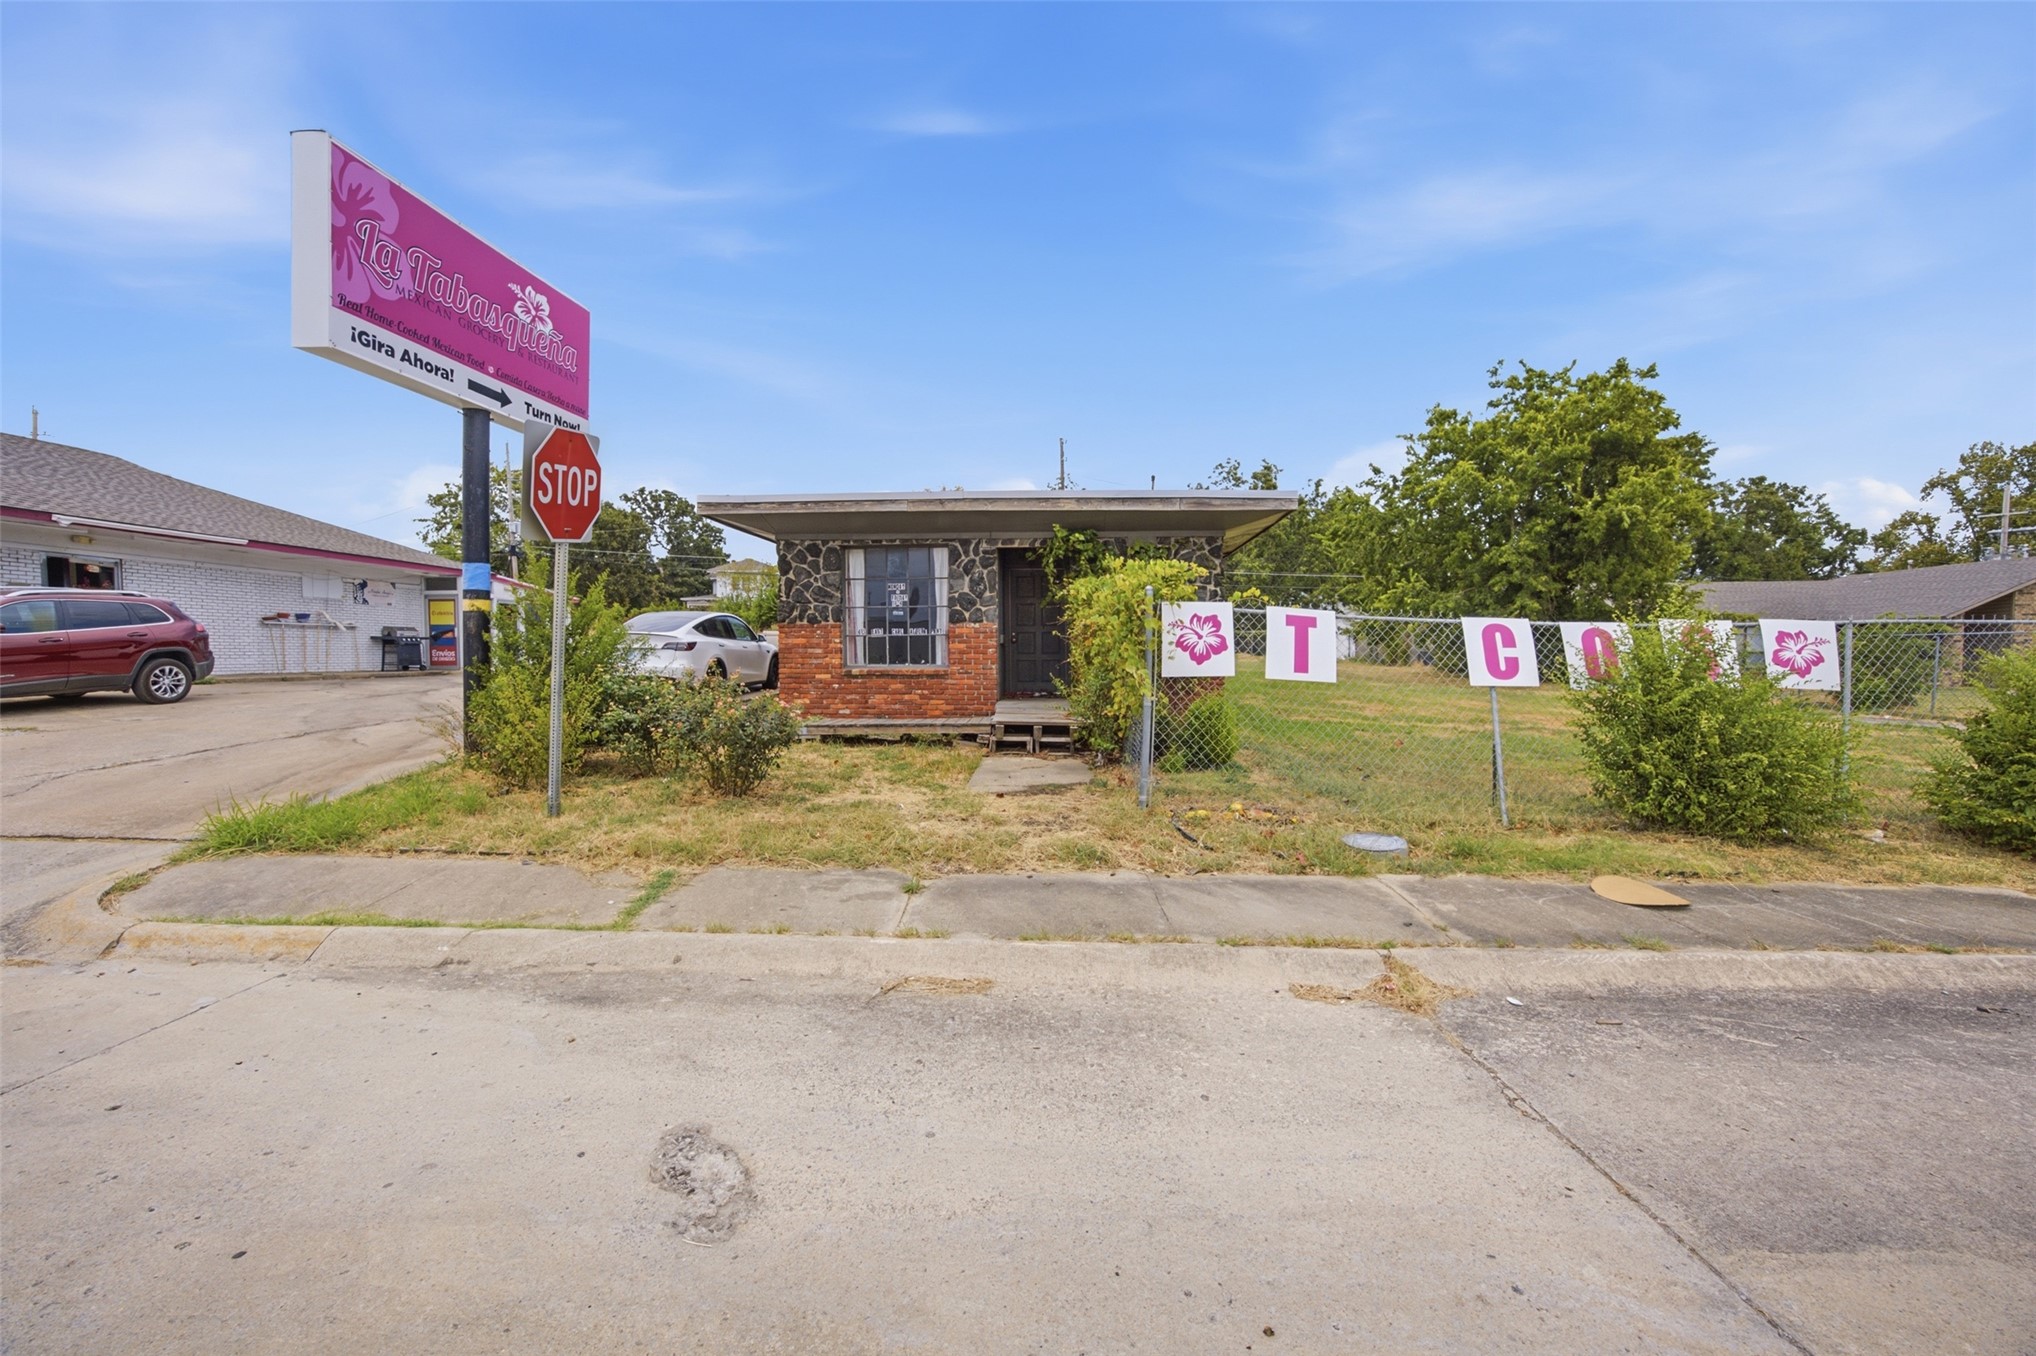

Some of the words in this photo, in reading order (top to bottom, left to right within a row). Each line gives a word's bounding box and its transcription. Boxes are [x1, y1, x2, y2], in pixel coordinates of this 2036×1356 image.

[355, 218, 402, 289] La
[407, 247, 578, 372] Tabasqueña
[337, 293, 363, 314] Real
[432, 337, 466, 361] Mexican
[466, 354, 486, 370] Food
[350, 326, 395, 359] ¡Gira
[399, 348, 455, 383] Ahora!
[395, 284, 452, 321] MEXICAN
[458, 317, 506, 349] GROCERY
[517, 346, 525, 357] &
[528, 351, 579, 385] RESTAURANT
[496, 368, 523, 387] Comida
[524, 381, 546, 398] Casera
[524, 401, 552, 423] Turn
[537, 461, 598, 507] STOP
